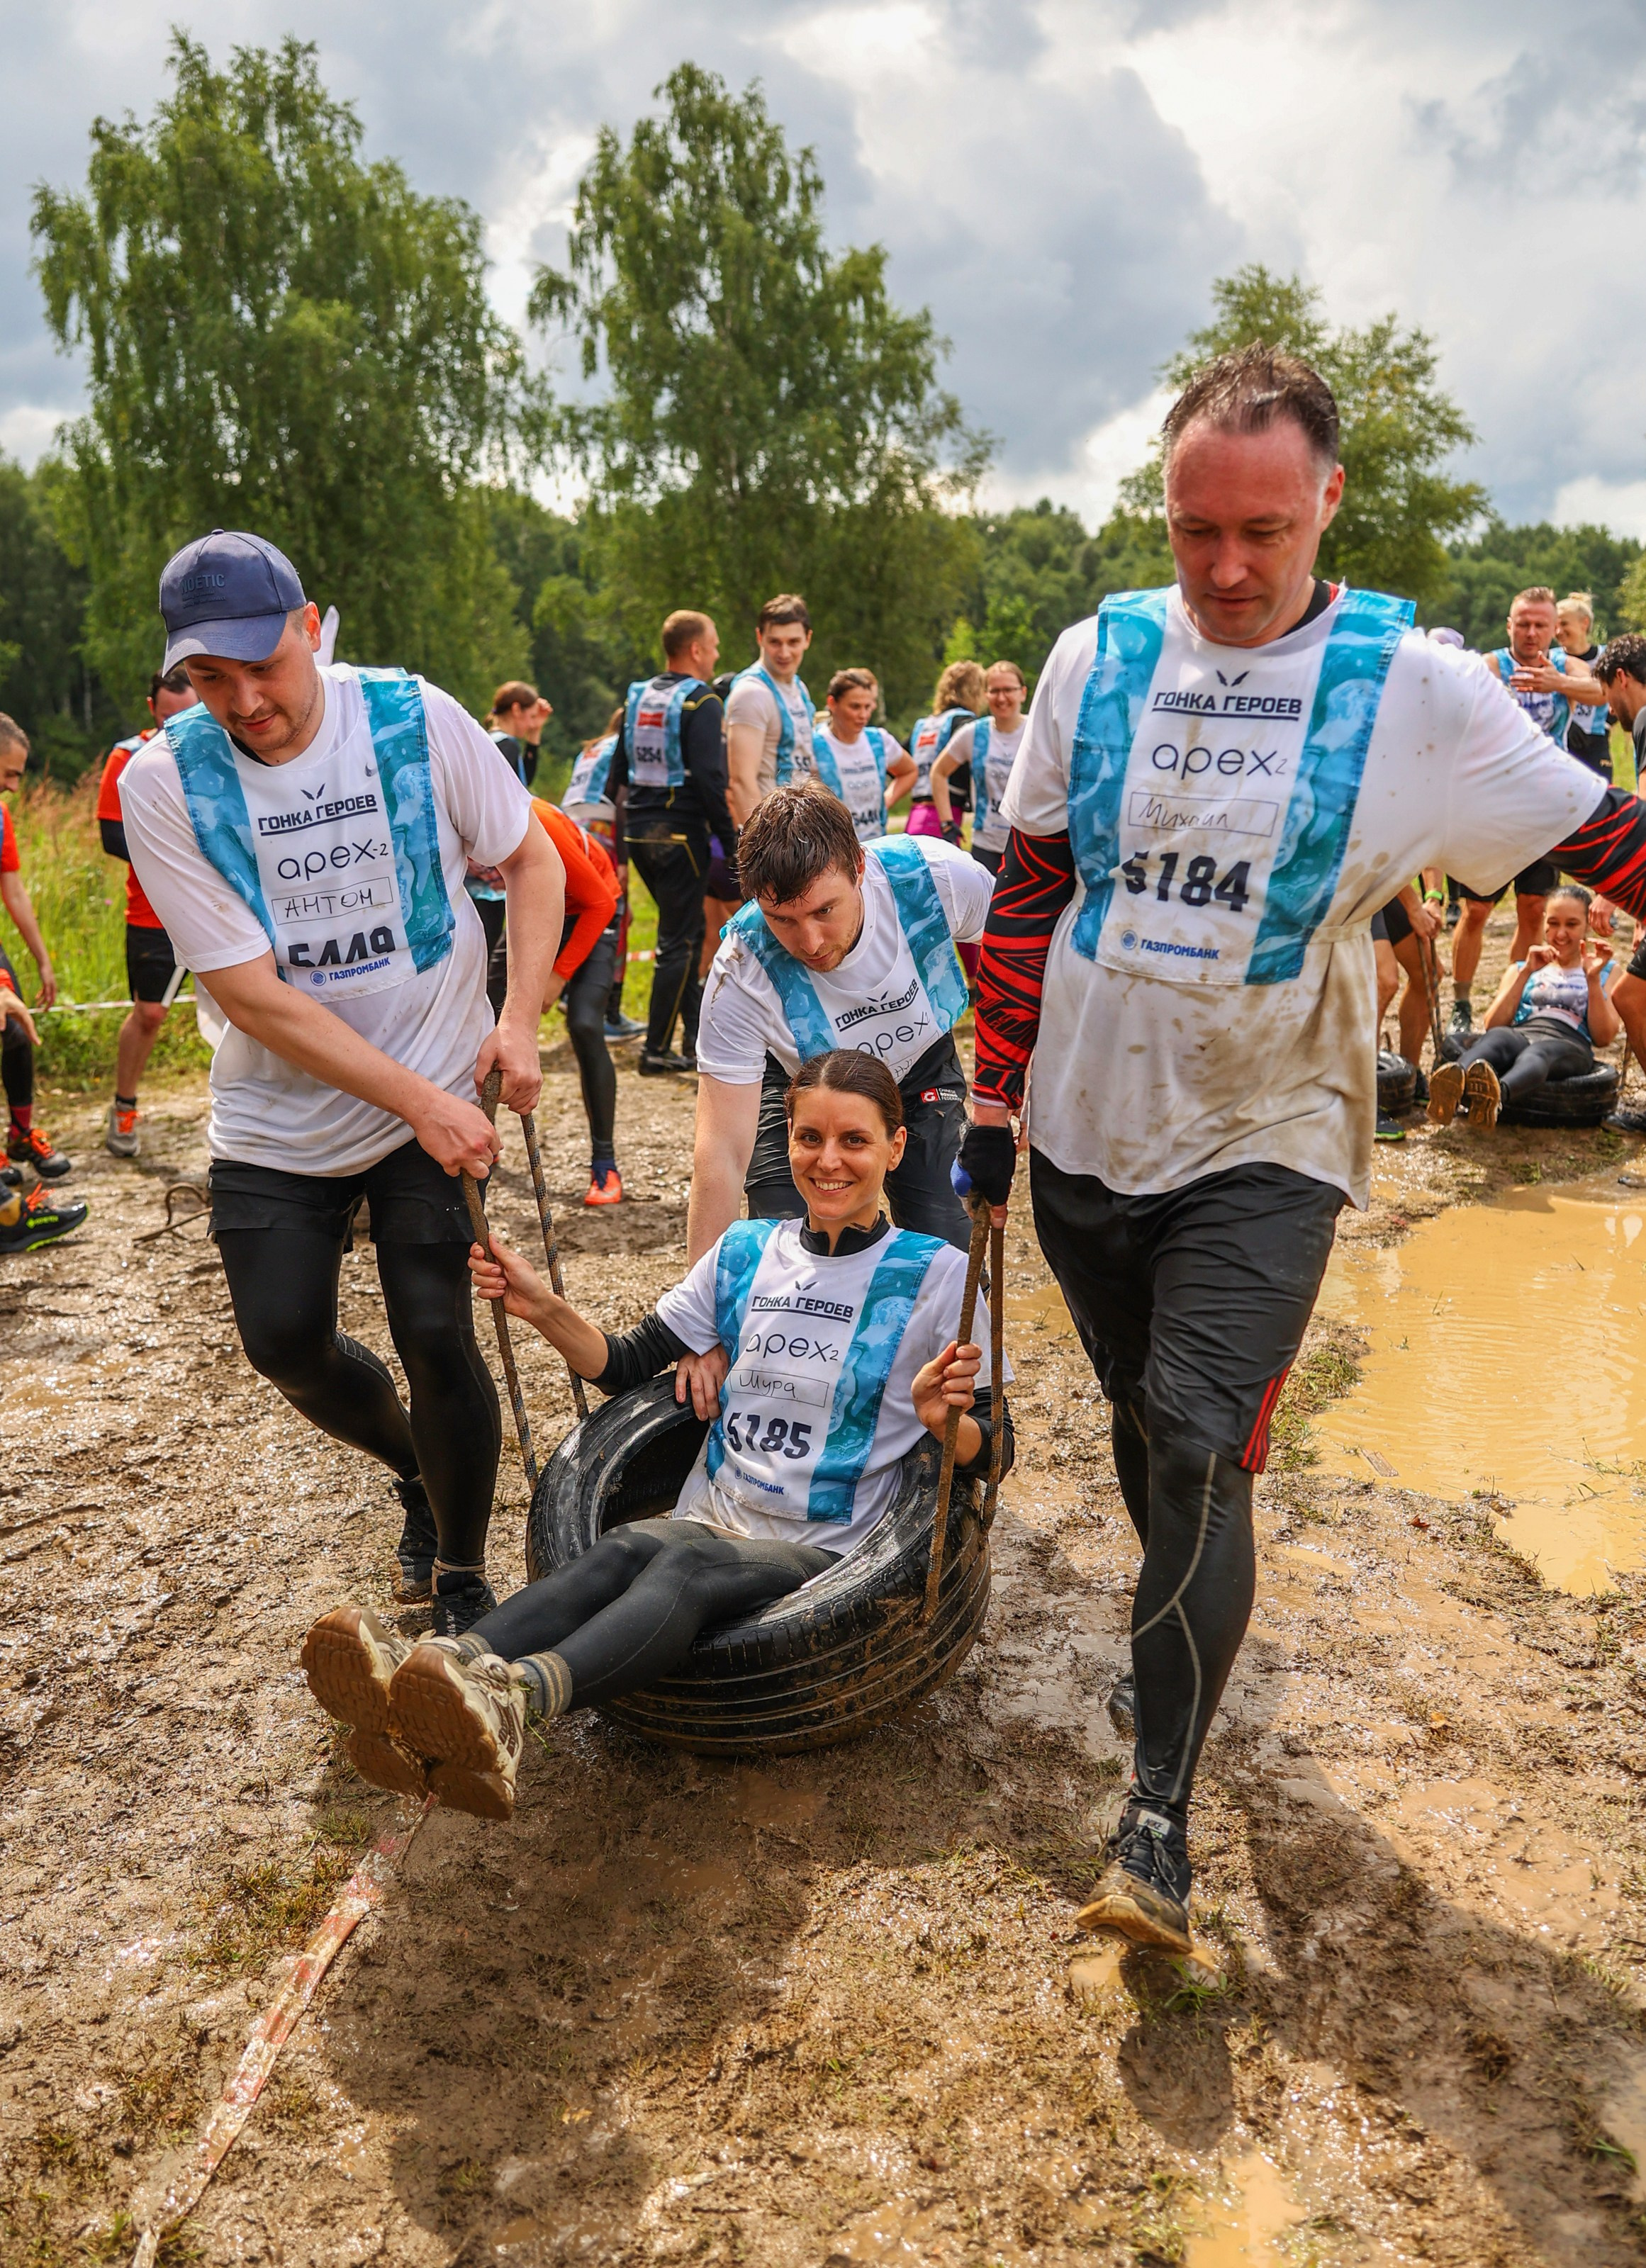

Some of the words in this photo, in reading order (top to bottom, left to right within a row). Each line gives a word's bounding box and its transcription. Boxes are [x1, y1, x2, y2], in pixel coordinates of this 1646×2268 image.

[180, 573, 225, 594] NOETIC
[1153, 692, 1216, 710] ГОНКА
[1223, 696, 1302, 714] ГЕРОЕВ
[1152, 743, 1277, 780] apex
[258, 810, 313, 831] ГОНКА
[316, 794, 377, 819] ГЕРОЕВ
[1138, 797, 1228, 828] Михаил
[1121, 850, 1251, 912] 5184
[1141, 938, 1219, 959] ГАЗПРОМБАНК
[329, 958, 391, 981] ГАЗПРОМБАНК
[835, 1006, 878, 1028] ГОНКА
[880, 978, 917, 1011] ГЕРОЕВ
[752, 1296, 790, 1308] ГОНКА
[795, 1297, 853, 1318] ГЕРОЕВ
[727, 1412, 812, 1459] 5185
[743, 1471, 785, 1495] ГАЗПРОМБАНК
